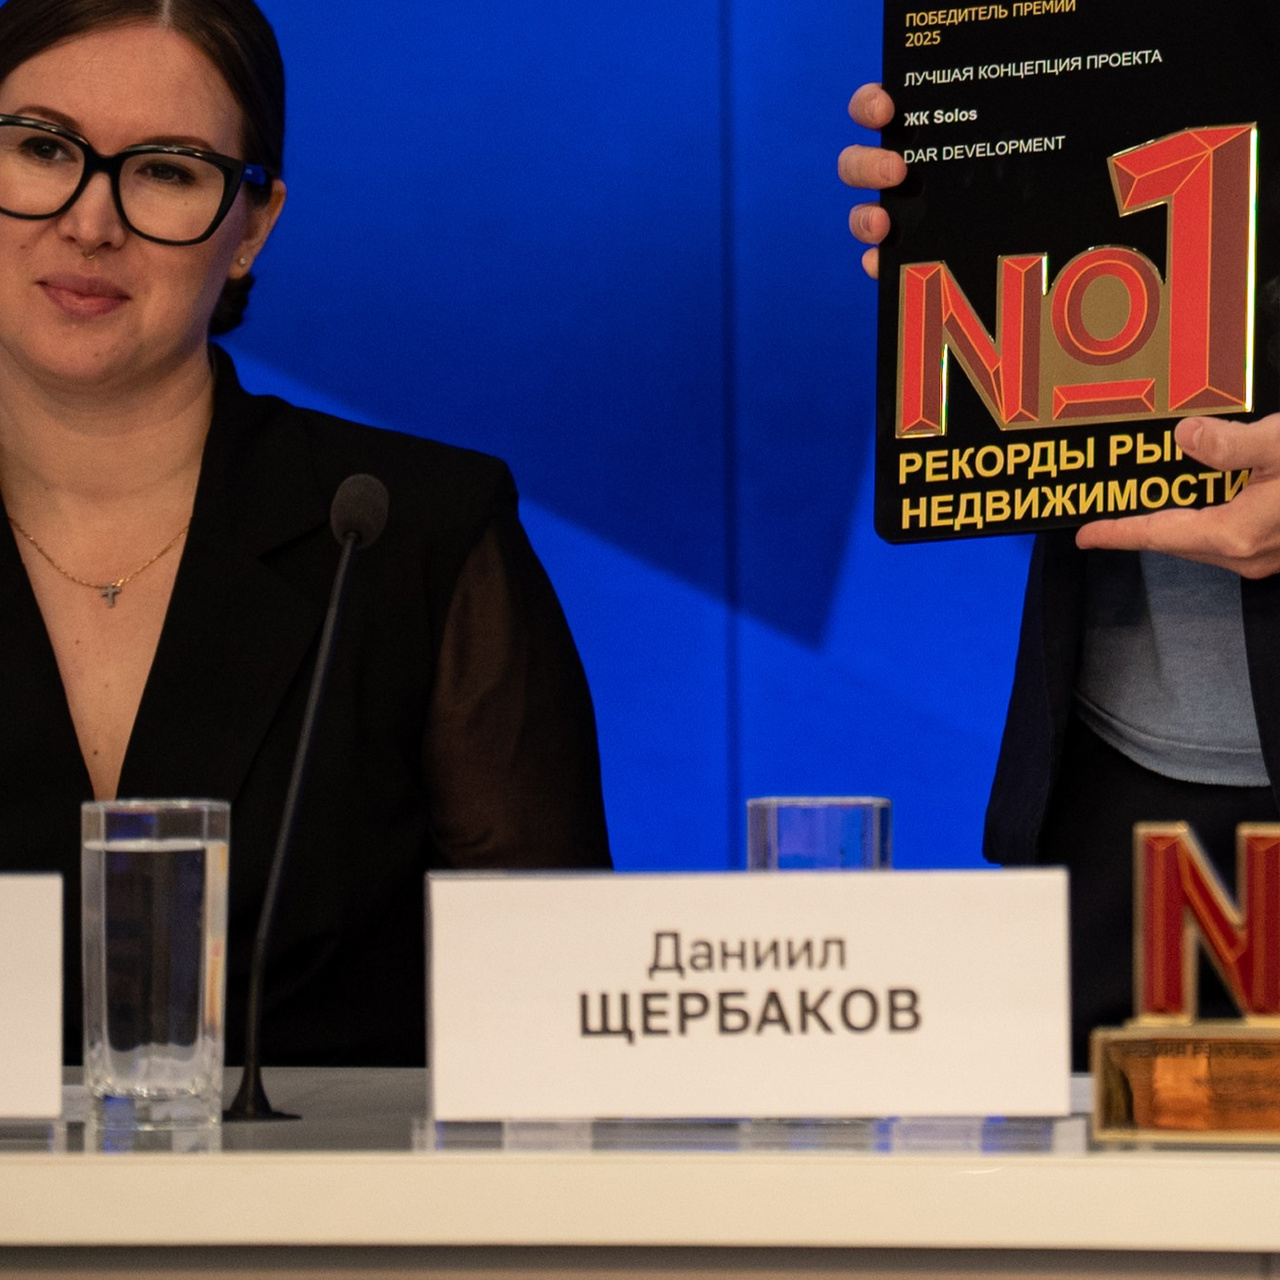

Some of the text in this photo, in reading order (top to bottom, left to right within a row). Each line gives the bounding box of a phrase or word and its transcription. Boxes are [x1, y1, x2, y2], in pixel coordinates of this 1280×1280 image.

[905, 4, 1008, 27] ПОБЕДИТЕЛЬ
[905, 31, 941, 47] 2025
[904, 50, 1162, 87] ЛУЧШАЯ КОНЦЕПЦИЯ ПРОЕКТА
[904, 108, 977, 126] ЖК Solos
[904, 136, 1065, 164] DAR DEVELOPMENT
[899, 431, 1184, 484] РЕКОРДЫ РЫ
[902, 469, 1250, 531] НЕДВИЖИМОСТИ
[648, 932, 846, 979] Даниил
[579, 988, 922, 1044] ЩЕРБАКОВ
